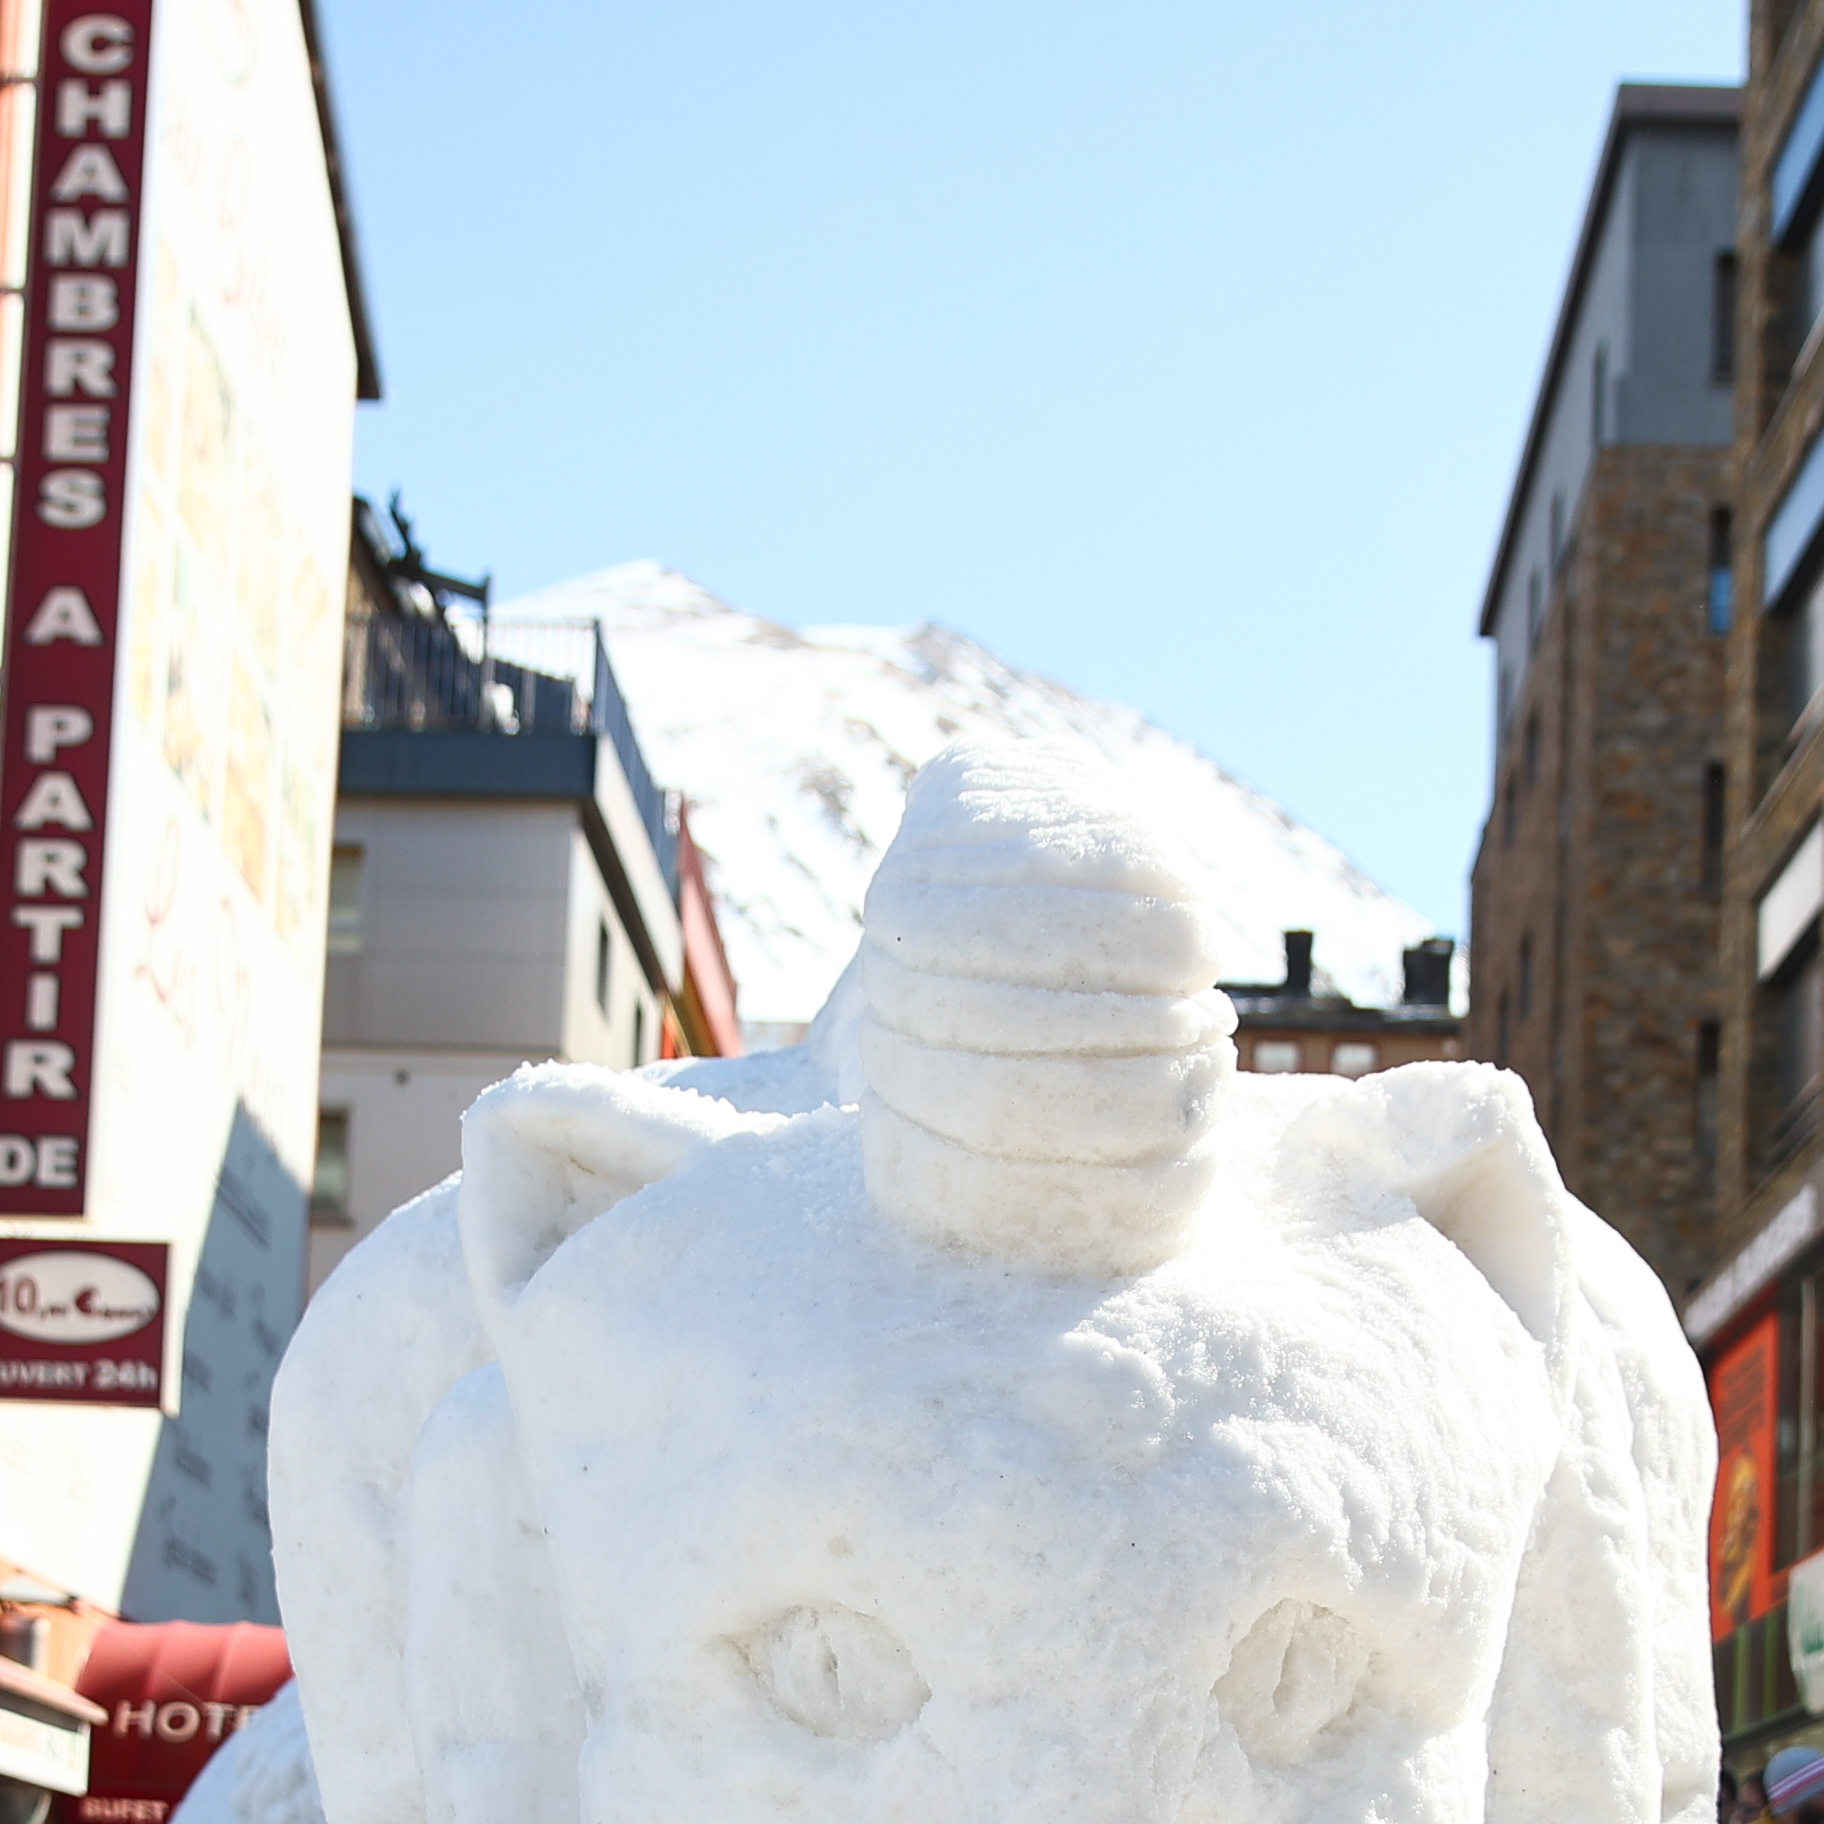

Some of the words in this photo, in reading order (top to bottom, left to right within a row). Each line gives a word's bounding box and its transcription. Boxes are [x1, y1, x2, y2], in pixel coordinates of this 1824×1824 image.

[35, 13, 136, 530] CHAMBRES
[22, 583, 105, 647] A
[2, 703, 94, 1099] PARTIR
